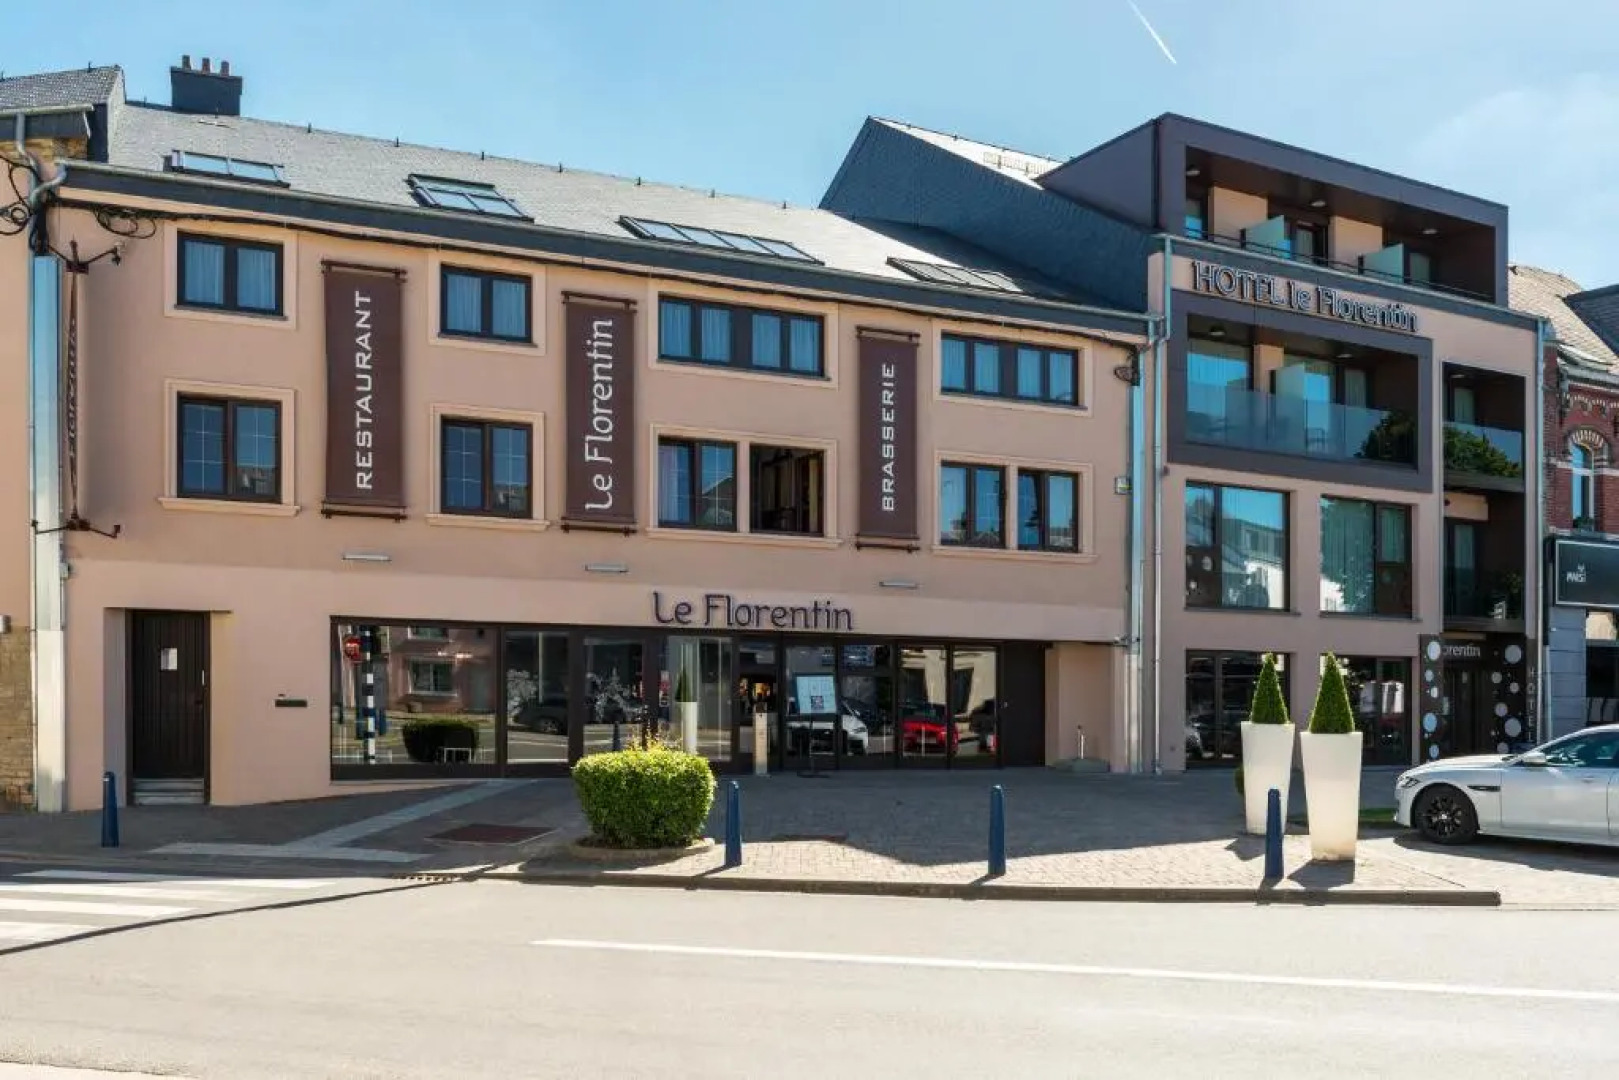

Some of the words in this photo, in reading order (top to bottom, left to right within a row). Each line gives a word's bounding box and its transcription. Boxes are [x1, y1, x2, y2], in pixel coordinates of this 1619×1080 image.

[1192, 260, 1285, 306] HOTEL
[1290, 280, 1312, 311] le
[1317, 285, 1418, 333] Florentin
[355, 291, 373, 490] RESTAURANT
[585, 319, 612, 463] Florentin
[882, 363, 895, 511] BRASSERIE
[585, 473, 612, 510] Le
[653, 591, 692, 625] Le
[704, 594, 853, 630] Florentin
